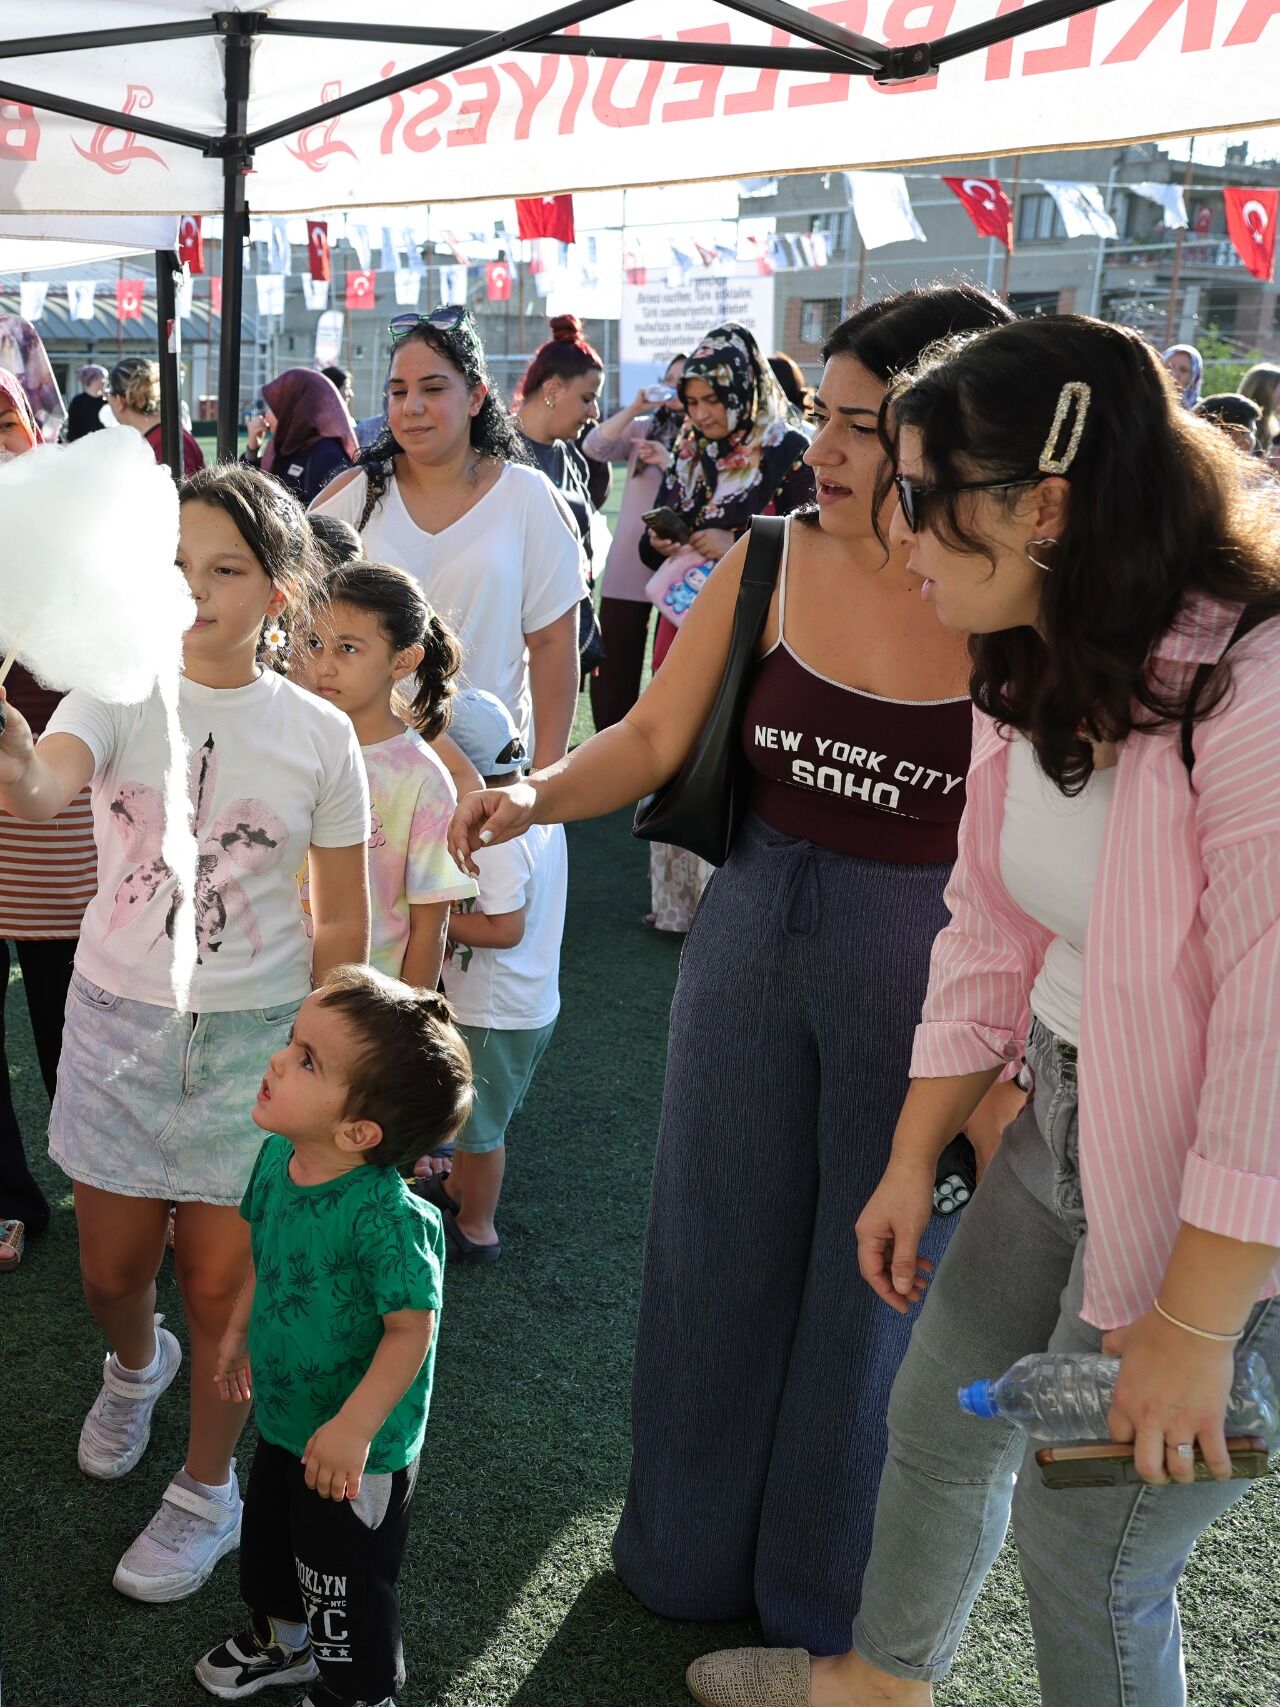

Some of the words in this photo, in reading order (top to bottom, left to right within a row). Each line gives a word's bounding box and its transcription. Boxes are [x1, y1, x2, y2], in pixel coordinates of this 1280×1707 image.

[754, 725, 803, 751] NEW
[815, 736, 887, 773] YORK
[894, 760, 964, 795] CITY
[791, 759, 900, 809] SOHO
